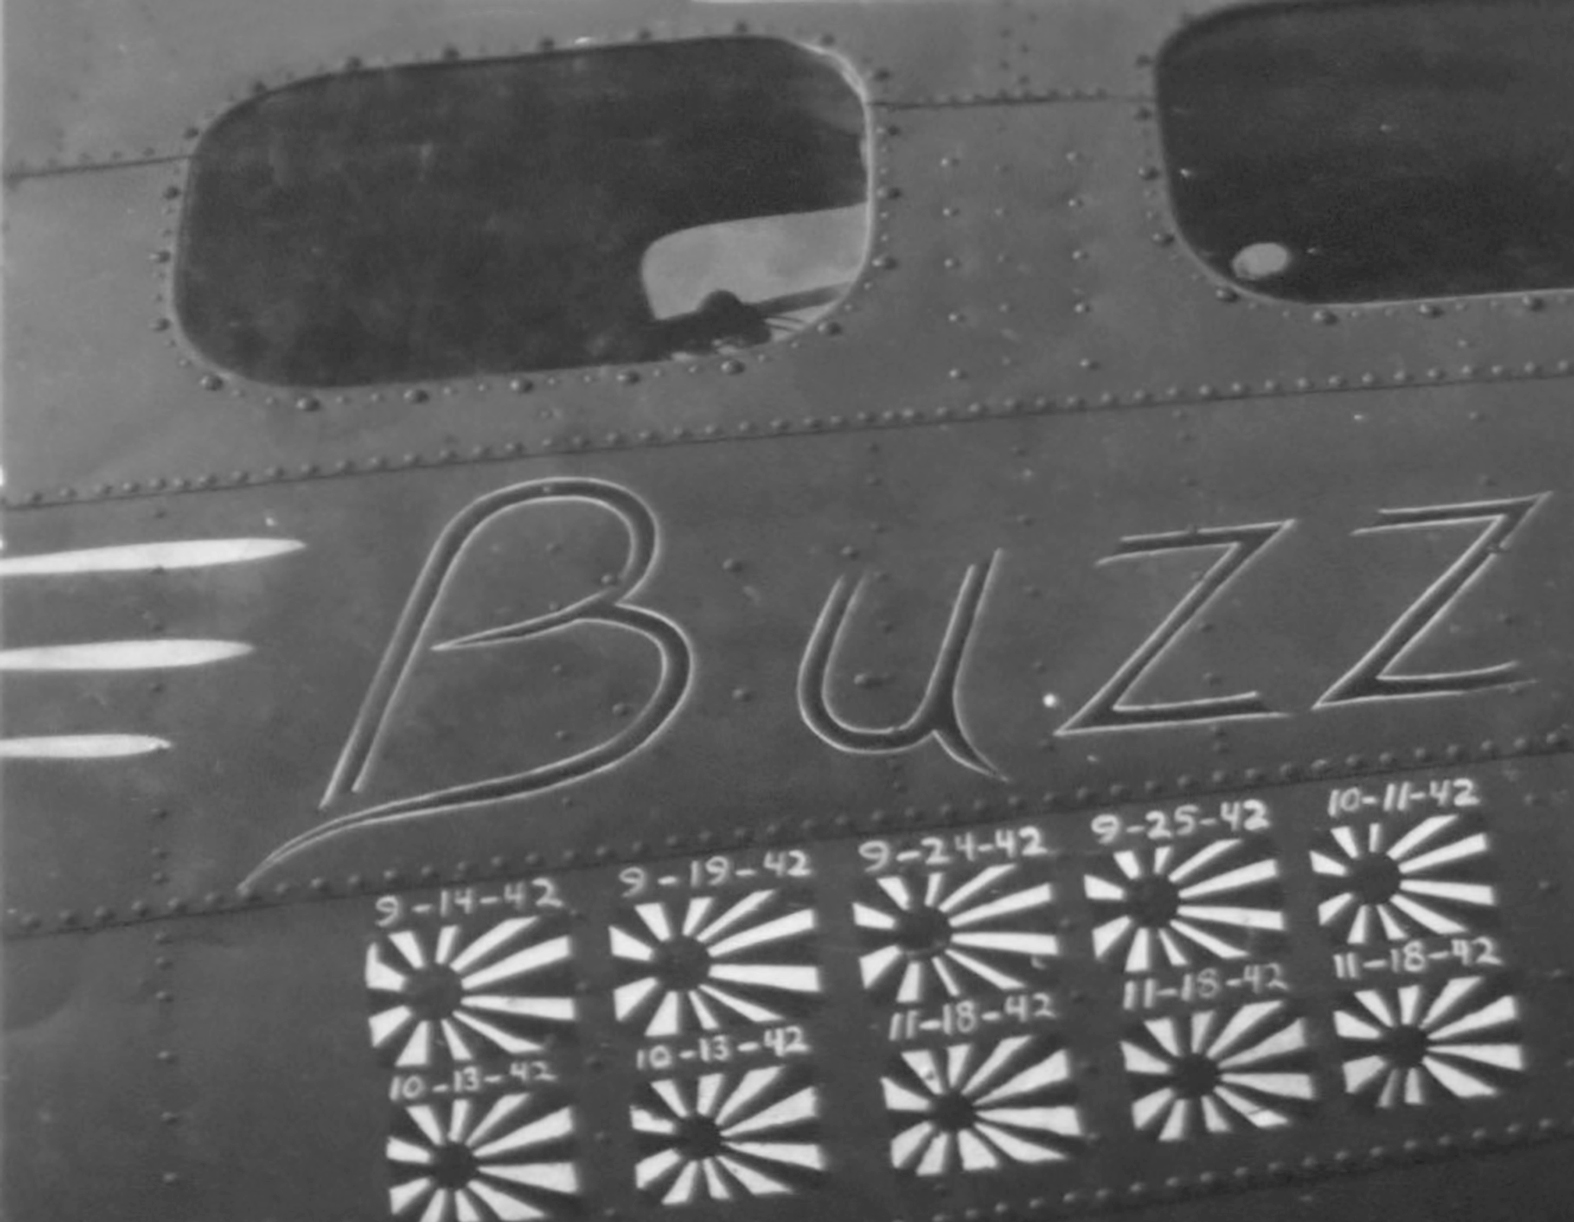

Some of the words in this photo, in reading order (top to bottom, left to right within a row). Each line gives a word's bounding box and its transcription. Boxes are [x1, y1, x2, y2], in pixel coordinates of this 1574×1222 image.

[239, 476, 1554, 894] Buzz
[1327, 777, 1482, 818] 10-11-42
[1090, 799, 1272, 844] 9-25-42
[858, 826, 1052, 873] 9-24-42
[618, 849, 814, 898] 9-19-42
[374, 876, 566, 927] 9-14-42
[1333, 936, 1504, 979] 11-18-42
[1122, 962, 1291, 1010] 11-18-42
[889, 993, 1058, 1041] 11-18-42
[636, 1025, 812, 1070] 10-13-42
[389, 1060, 558, 1100] 10-13-42
